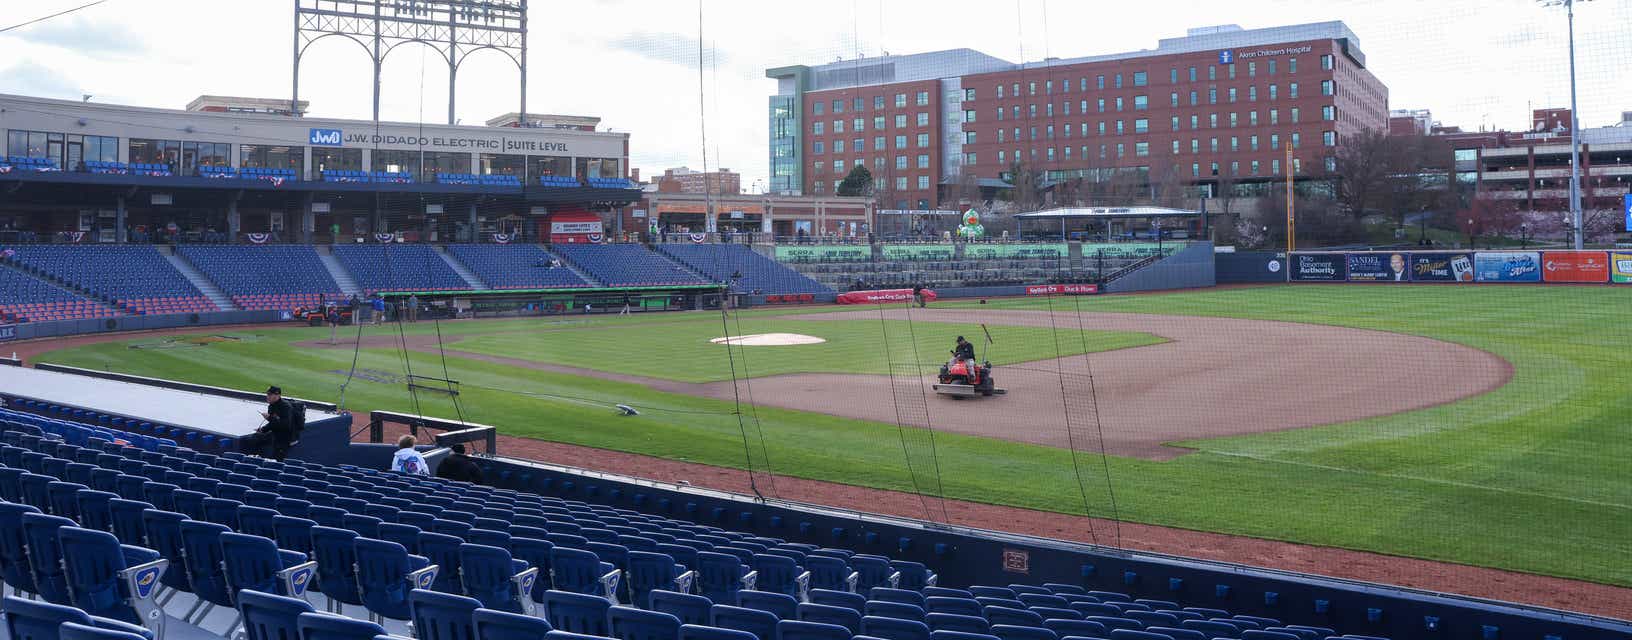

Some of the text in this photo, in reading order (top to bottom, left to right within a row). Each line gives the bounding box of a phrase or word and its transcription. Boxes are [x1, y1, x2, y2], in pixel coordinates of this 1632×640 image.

[1286, 46, 1312, 55] Hospital
[344, 134, 500, 149] J.W. DIDADO ELECTRIC
[507, 140, 569, 152] SUITE LEVEL
[1299, 267, 1336, 275] Authority
[1431, 269, 1449, 277] TIME
